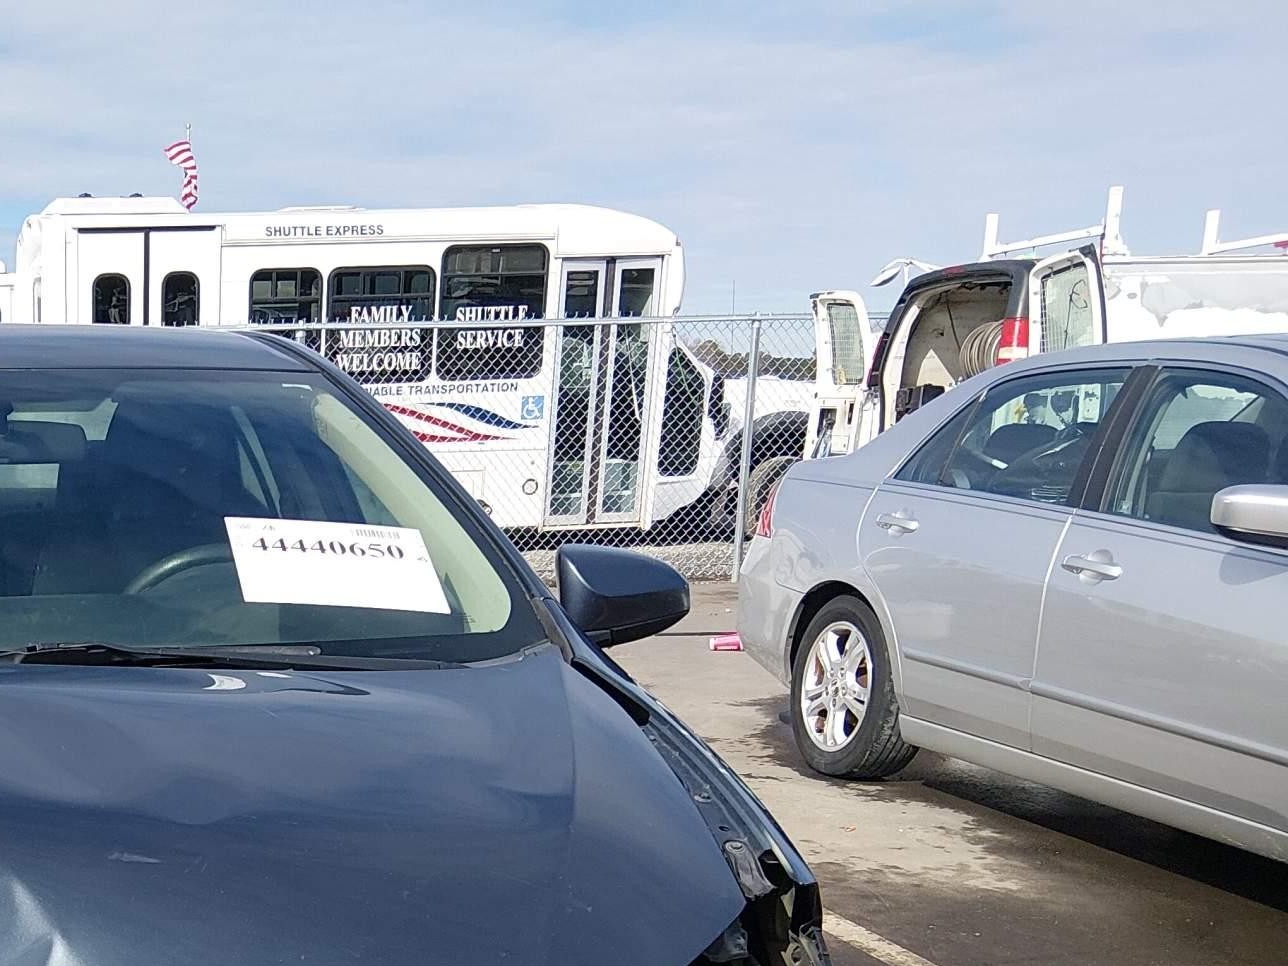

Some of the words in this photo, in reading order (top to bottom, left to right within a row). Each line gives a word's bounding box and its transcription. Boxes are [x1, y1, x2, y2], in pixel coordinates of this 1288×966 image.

[265, 225, 322, 237] SHUTTLE
[326, 224, 384, 236] EXPRESS
[351, 305, 413, 323] FAMILY
[456, 305, 528, 322] SHUTTLE
[339, 328, 421, 348] MEMBERS
[456, 329, 524, 349] SERVICE
[336, 352, 422, 373] WELCOME
[407, 383, 518, 396] TRANSPORTATION
[252, 537, 404, 559] 44440650
